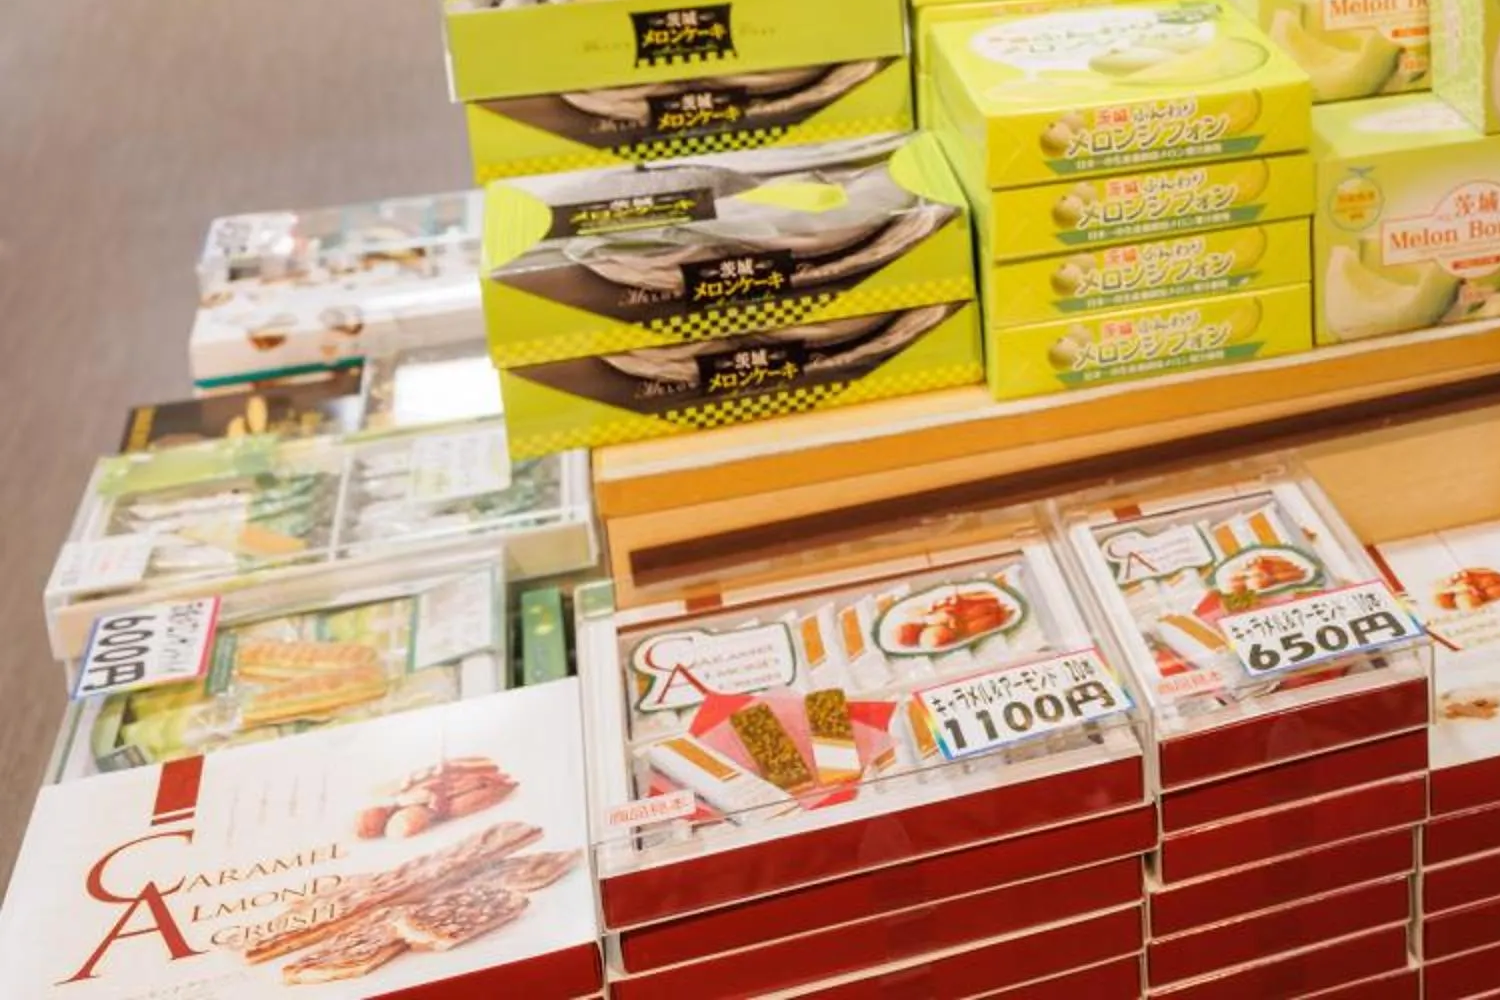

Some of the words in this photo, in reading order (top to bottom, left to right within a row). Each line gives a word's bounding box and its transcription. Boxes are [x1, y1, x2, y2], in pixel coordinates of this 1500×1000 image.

[641, 23, 727, 47] メロンケーキ
[656, 106, 742, 130] メロンケーキ
[1066, 115, 1229, 157] メロンシフォン
[1077, 183, 1239, 229] メロンシフォン
[1389, 226, 1459, 252] Melon
[693, 271, 784, 299] メロンケーキ
[719, 259, 755, 278] 茨城
[1075, 251, 1235, 295] メロンシフォン
[734, 349, 769, 368] 茨城
[1072, 324, 1231, 368] メロンシフォン
[708, 362, 799, 390] メロンケーキ
[84, 613, 159, 693] 600円
[1248, 608, 1409, 672] 650円
[942, 678, 1117, 752] 1100円
[85, 828, 349, 904] CARAMEL
[54, 873, 348, 986] ALMOND
[209, 900, 353, 948] CRUSH
